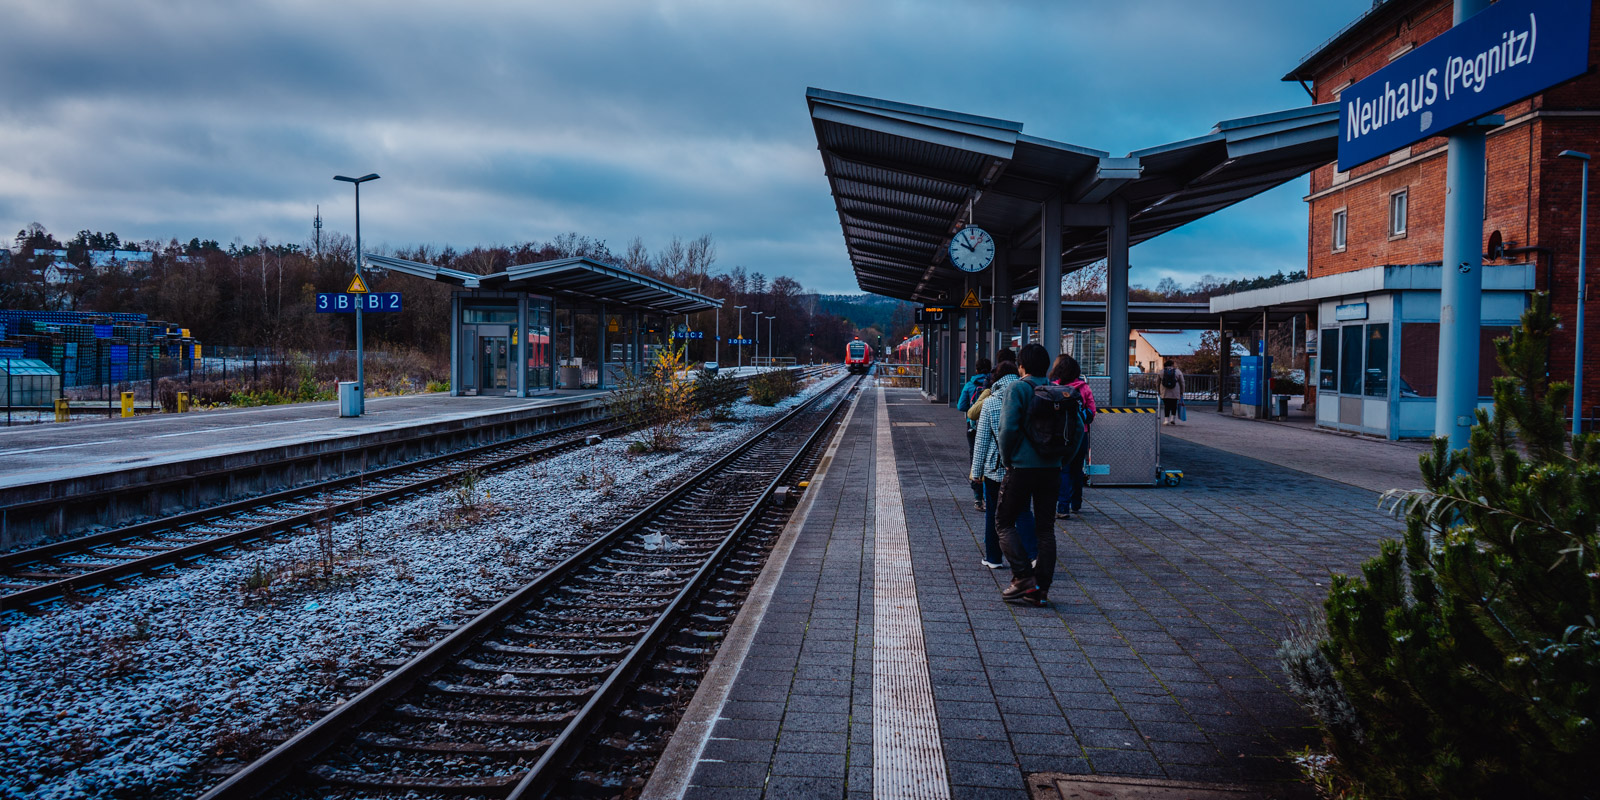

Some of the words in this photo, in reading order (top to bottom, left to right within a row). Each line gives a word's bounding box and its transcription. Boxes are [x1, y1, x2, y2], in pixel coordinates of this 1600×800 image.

[1347, 68, 1438, 142] Neuhaus
[1444, 12, 1537, 101] (Pegnitz)
[319, 295, 328, 308] 3
[338, 295, 348, 308] B
[369, 295, 379, 308] B
[390, 294, 399, 308] 2
[917, 309, 922, 320] 1
